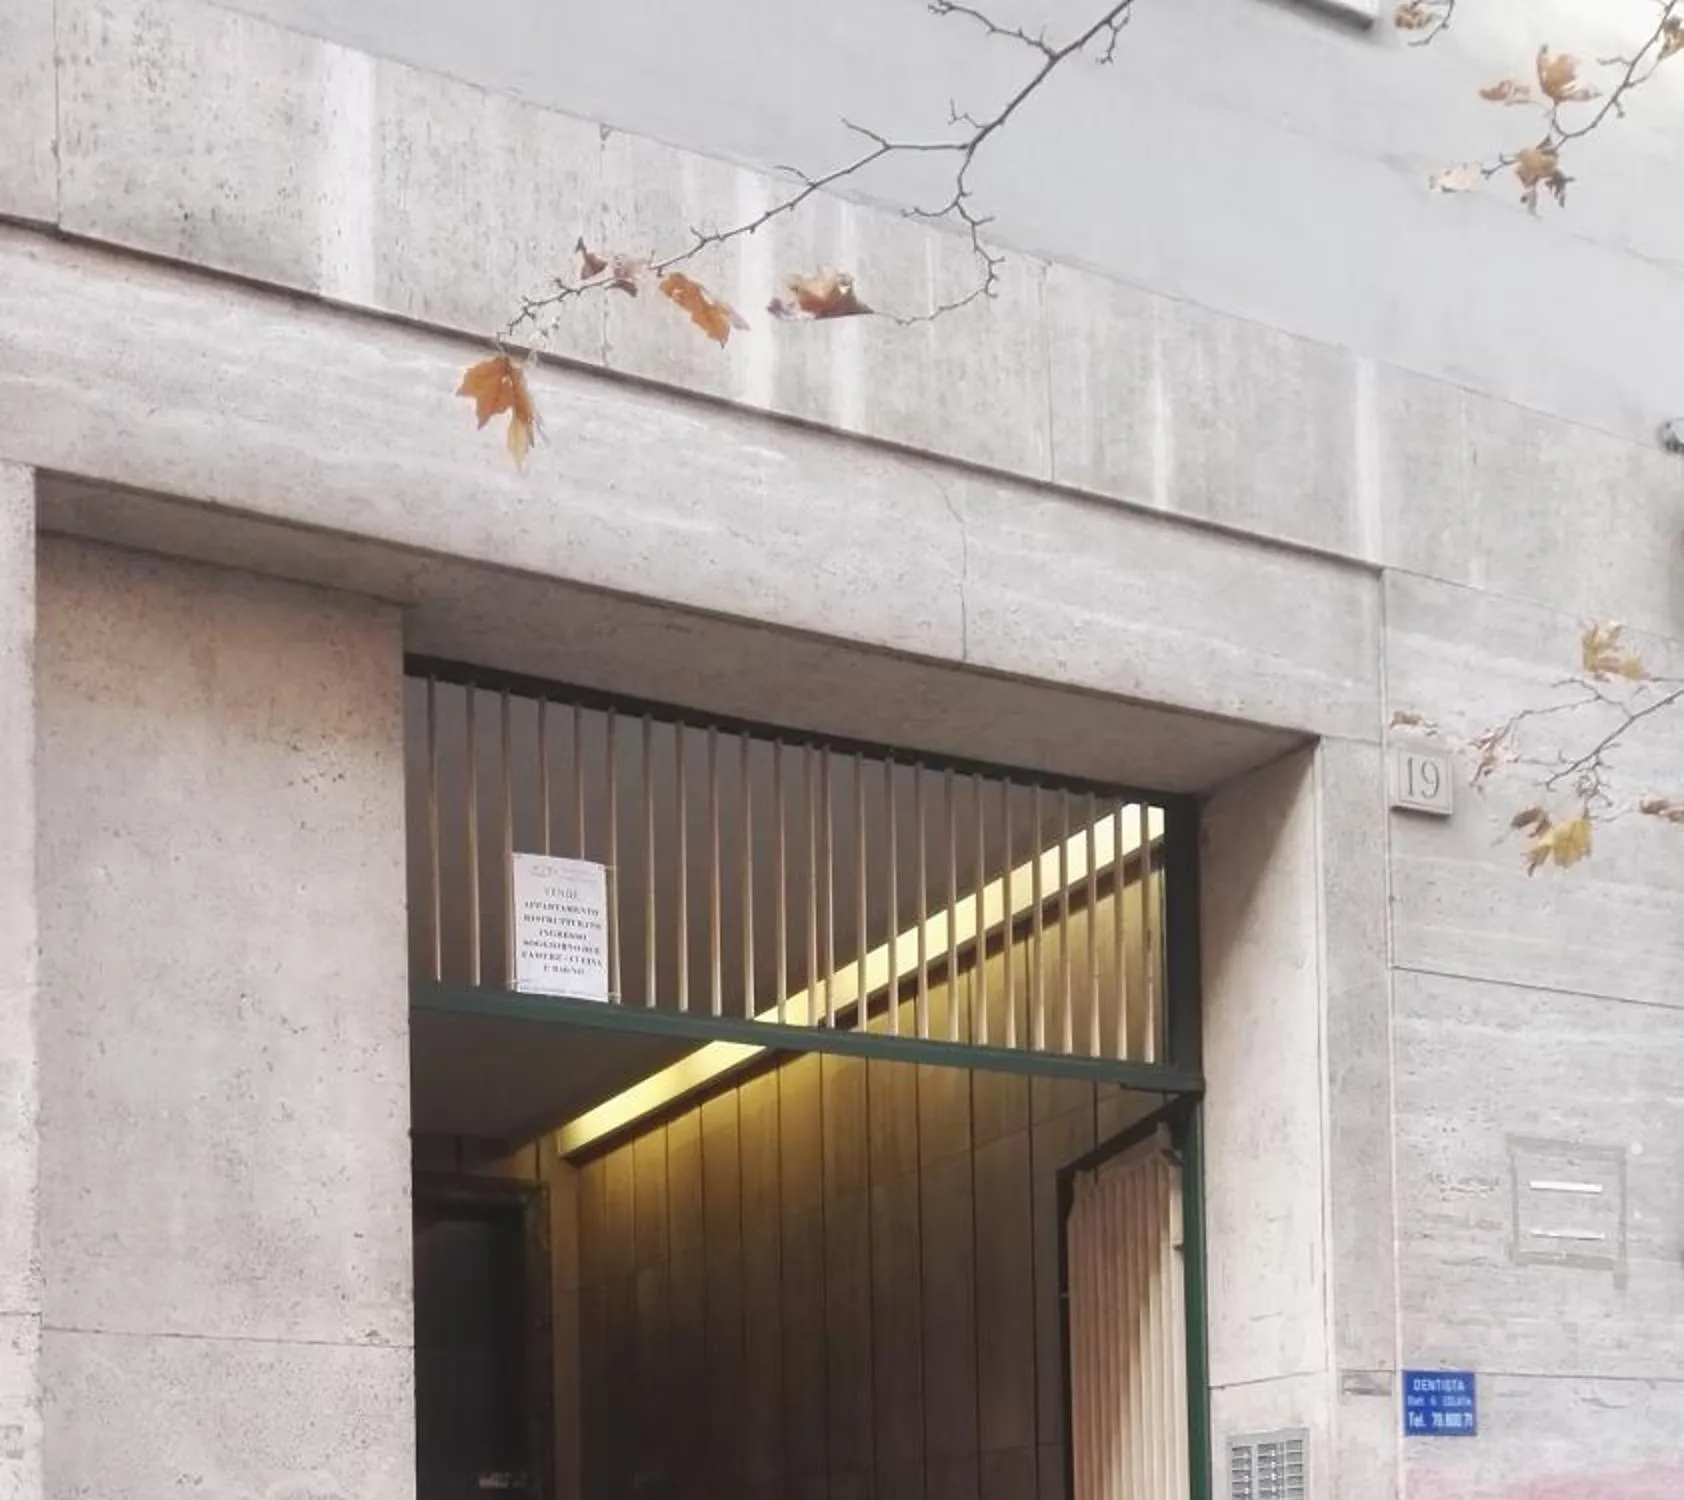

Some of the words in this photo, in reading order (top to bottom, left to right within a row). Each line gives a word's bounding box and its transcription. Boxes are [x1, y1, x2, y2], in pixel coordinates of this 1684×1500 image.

[1407, 756, 1440, 800] 19
[1412, 1378, 1466, 1392] DENTISTA
[1408, 1411, 1427, 1428] Tel.
